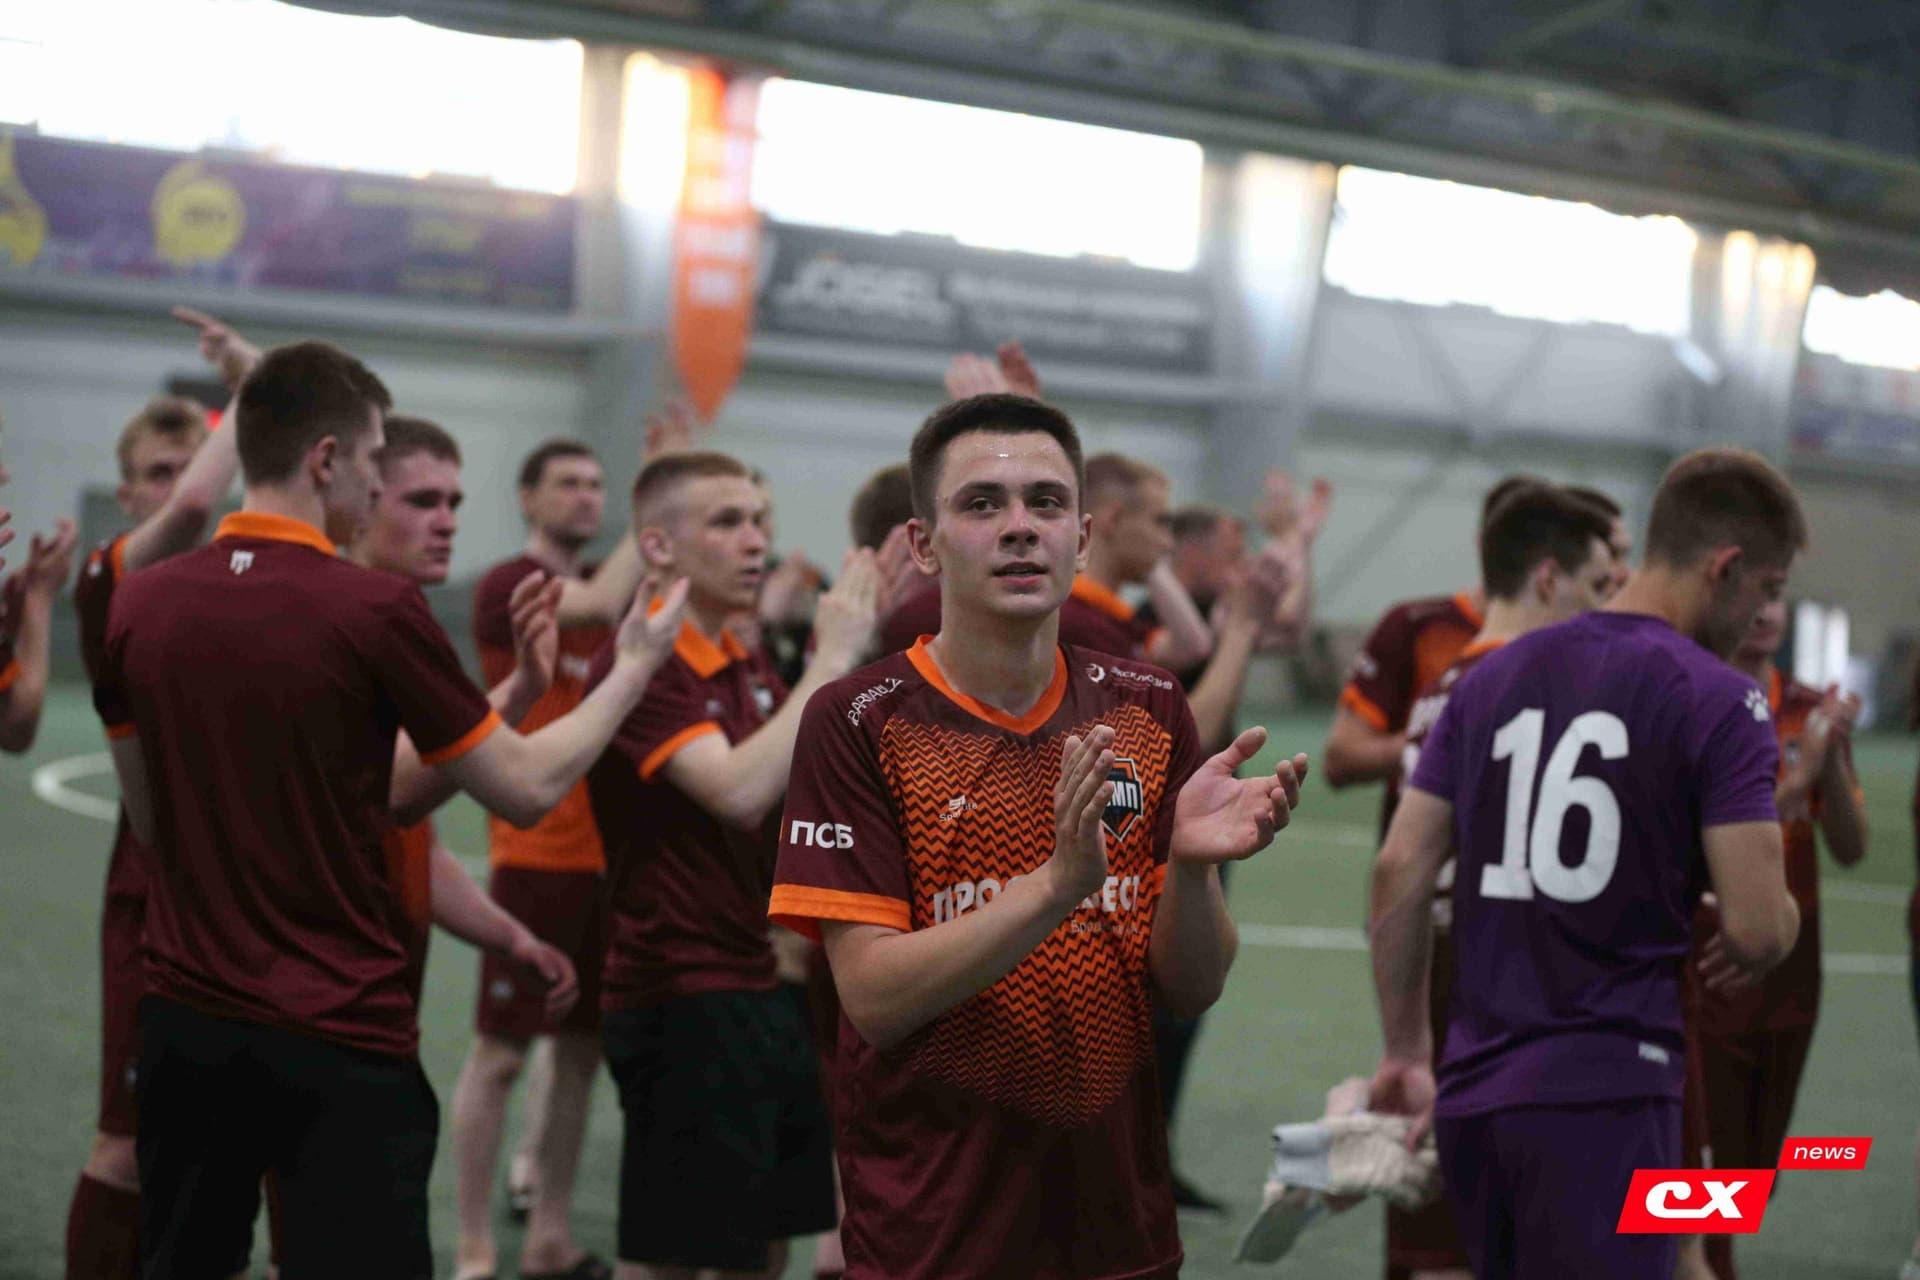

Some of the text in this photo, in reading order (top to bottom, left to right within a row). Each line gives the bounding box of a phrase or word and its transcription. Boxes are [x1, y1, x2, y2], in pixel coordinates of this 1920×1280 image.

[1104, 780, 1138, 810] МП
[1479, 707, 1630, 904] 16
[790, 820, 854, 849] ПСБ
